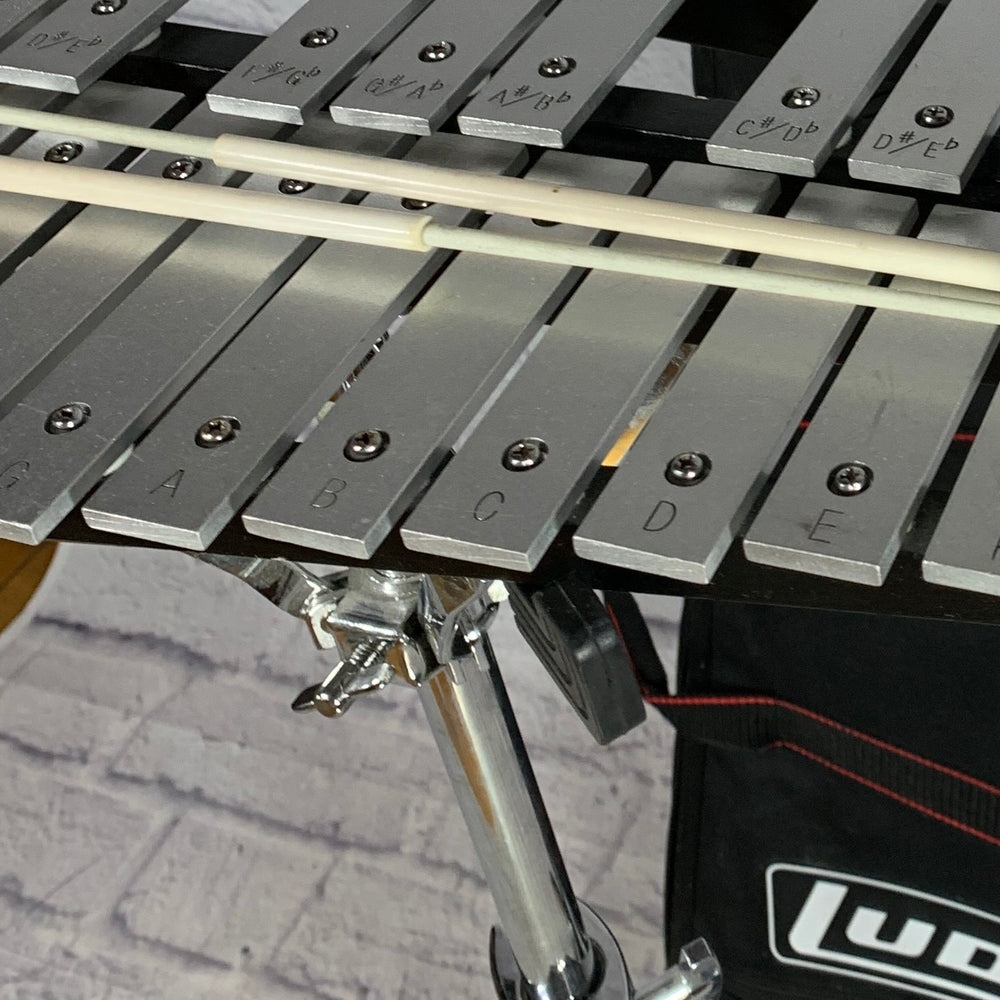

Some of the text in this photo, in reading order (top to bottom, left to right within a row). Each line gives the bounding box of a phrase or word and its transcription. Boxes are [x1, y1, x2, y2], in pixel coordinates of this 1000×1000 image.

[149, 468, 185, 498] A
[310, 477, 347, 509] B
[473, 490, 505, 522] C
[642, 500, 677, 532] D
[807, 508, 844, 544] E
